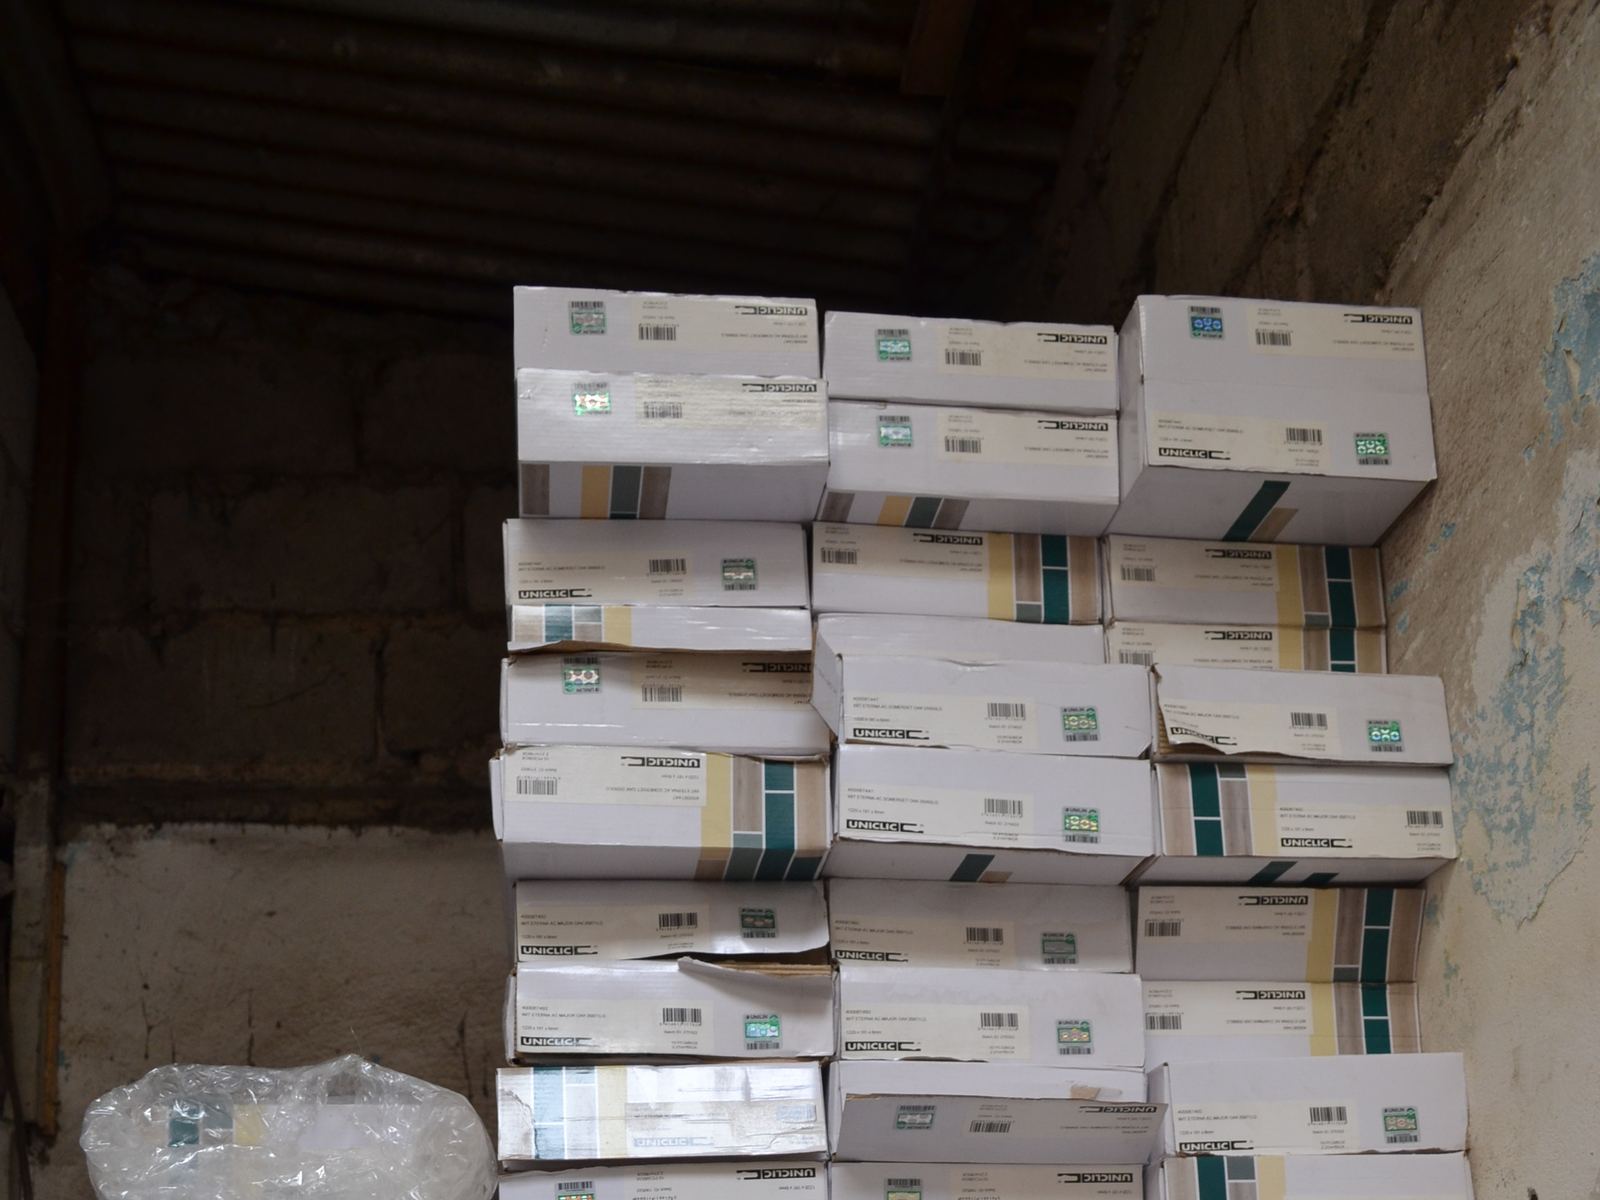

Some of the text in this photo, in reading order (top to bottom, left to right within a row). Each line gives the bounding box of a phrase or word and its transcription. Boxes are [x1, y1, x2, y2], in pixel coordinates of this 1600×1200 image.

[759, 305, 807, 316] UNICLIC
[1367, 315, 1411, 325] UNICLIC
[1059, 334, 1107, 345] UNICLIC
[767, 383, 815, 394] UNICLIC
[1060, 421, 1108, 432] UNICLIC
[1159, 448, 1207, 459] UNICLIC
[937, 536, 981, 546] UNICLIC
[1227, 550, 1271, 560] UNICLIC
[520, 590, 568, 599] UNICLIC
[1227, 631, 1271, 641] UNICLIC
[768, 662, 812, 674] NICLIC
[853, 727, 905, 740] UNICLIC
[646, 756, 700, 769] UNICLIC
[847, 819, 899, 832] UNICLIC
[1281, 837, 1329, 848] UNICLIC
[1260, 896, 1308, 905] UNICLIC
[521, 945, 573, 956] UNICLIC
[836, 950, 884, 961] UNICLIC
[1260, 991, 1304, 1001] UNICLIC
[521, 1036, 573, 1047] UNICLIC
[845, 1041, 897, 1052] UNICLIC
[1104, 1103, 1156, 1115] UNICLIC
[1181, 1142, 1229, 1151] UNICLIC
[763, 1169, 815, 1178] UNICLIC
[1081, 1173, 1133, 1182] UNICLIC
